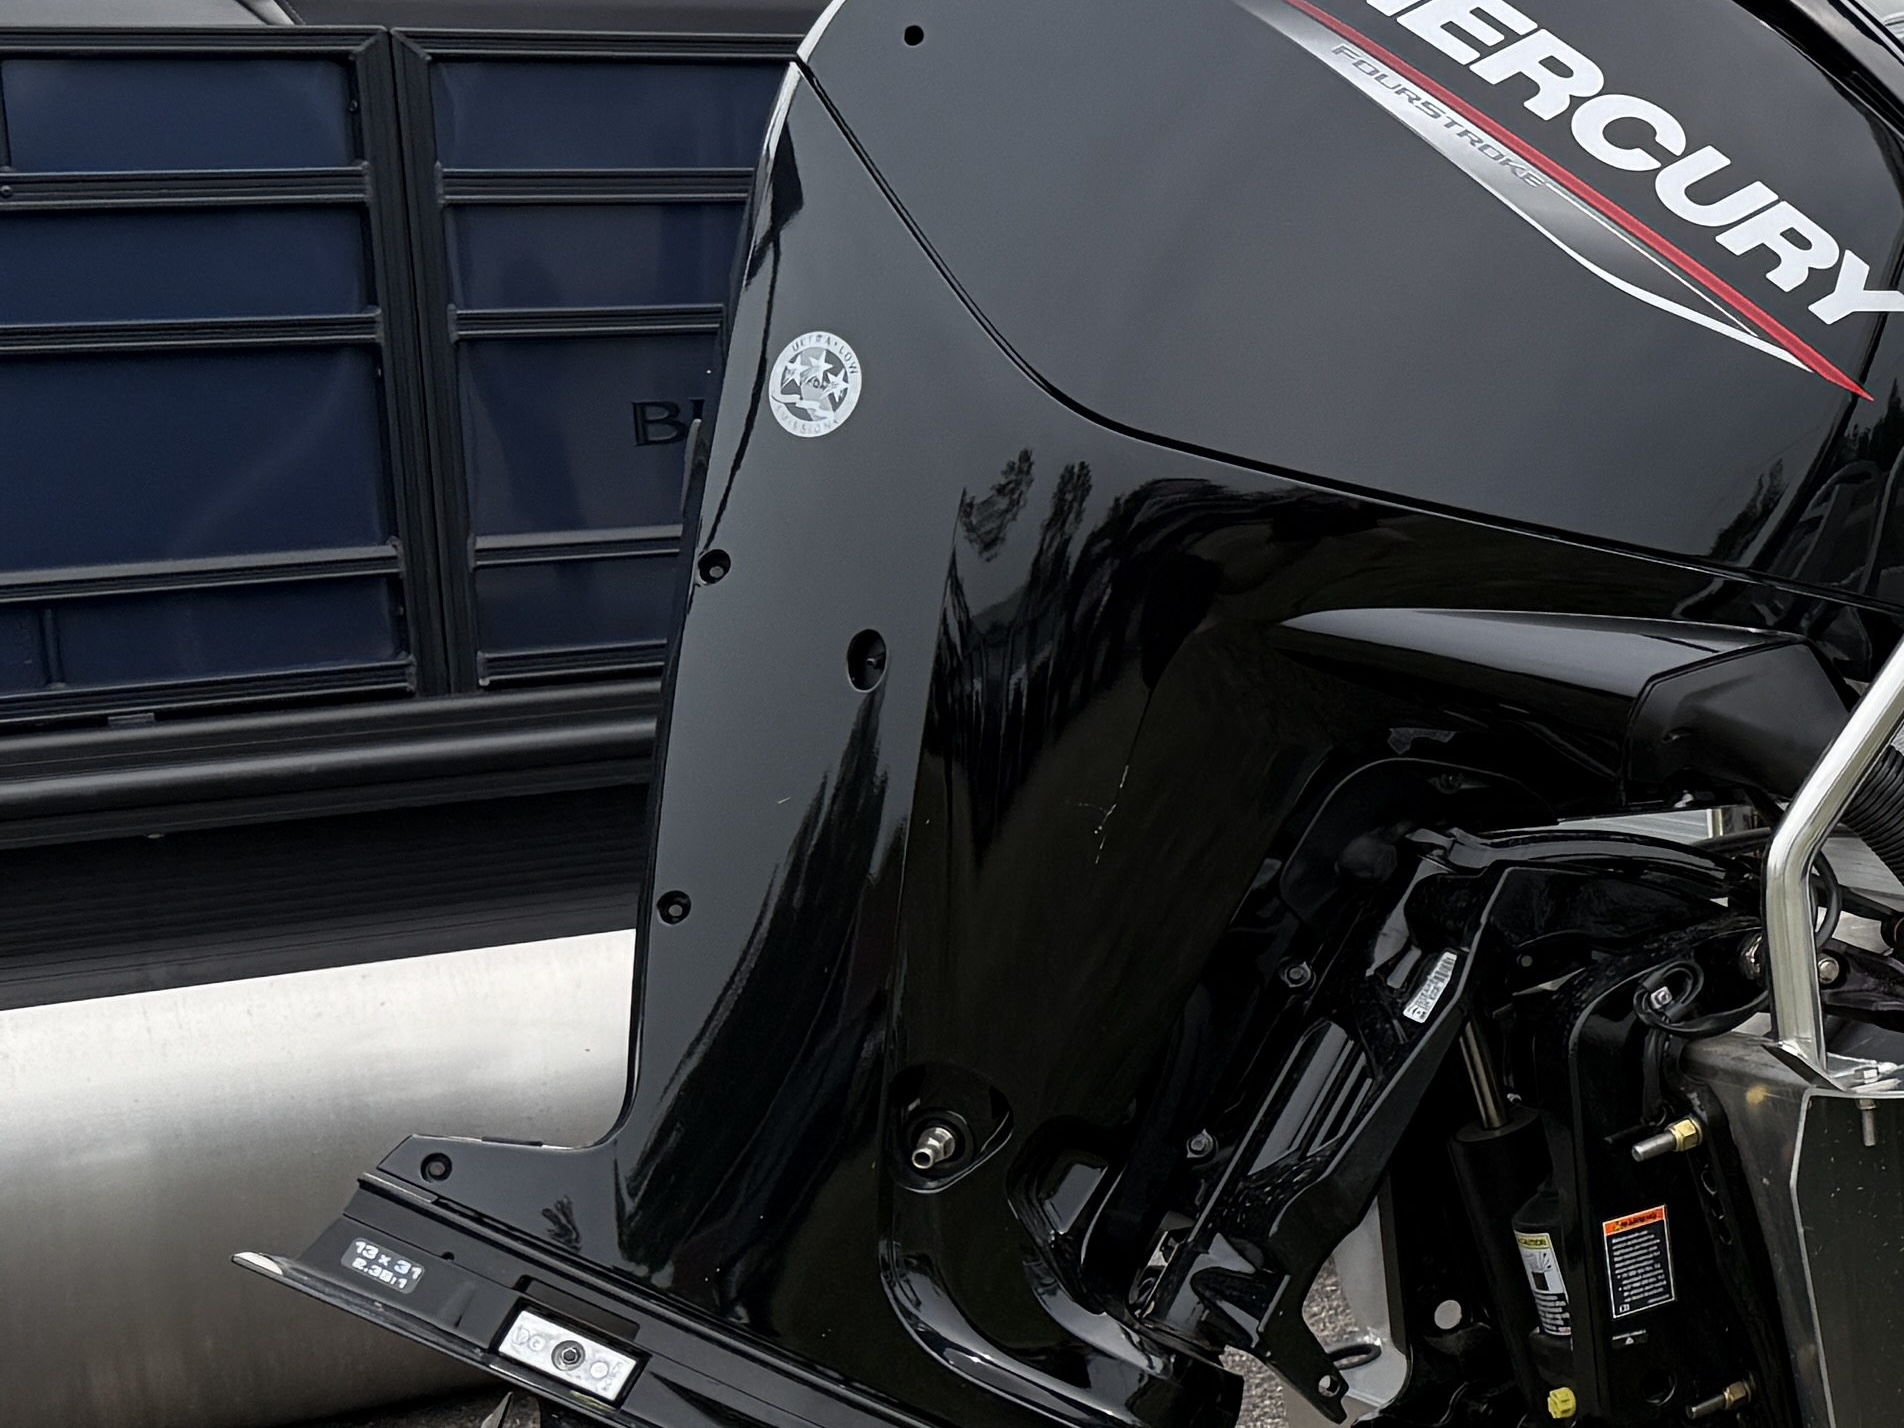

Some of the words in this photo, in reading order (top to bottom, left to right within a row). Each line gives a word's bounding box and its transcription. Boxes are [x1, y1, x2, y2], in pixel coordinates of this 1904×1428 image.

[1331, 43, 1548, 189] FOURSTROKE
[355, 1241, 379, 1260] 13
[394, 1259, 422, 1279] 31
